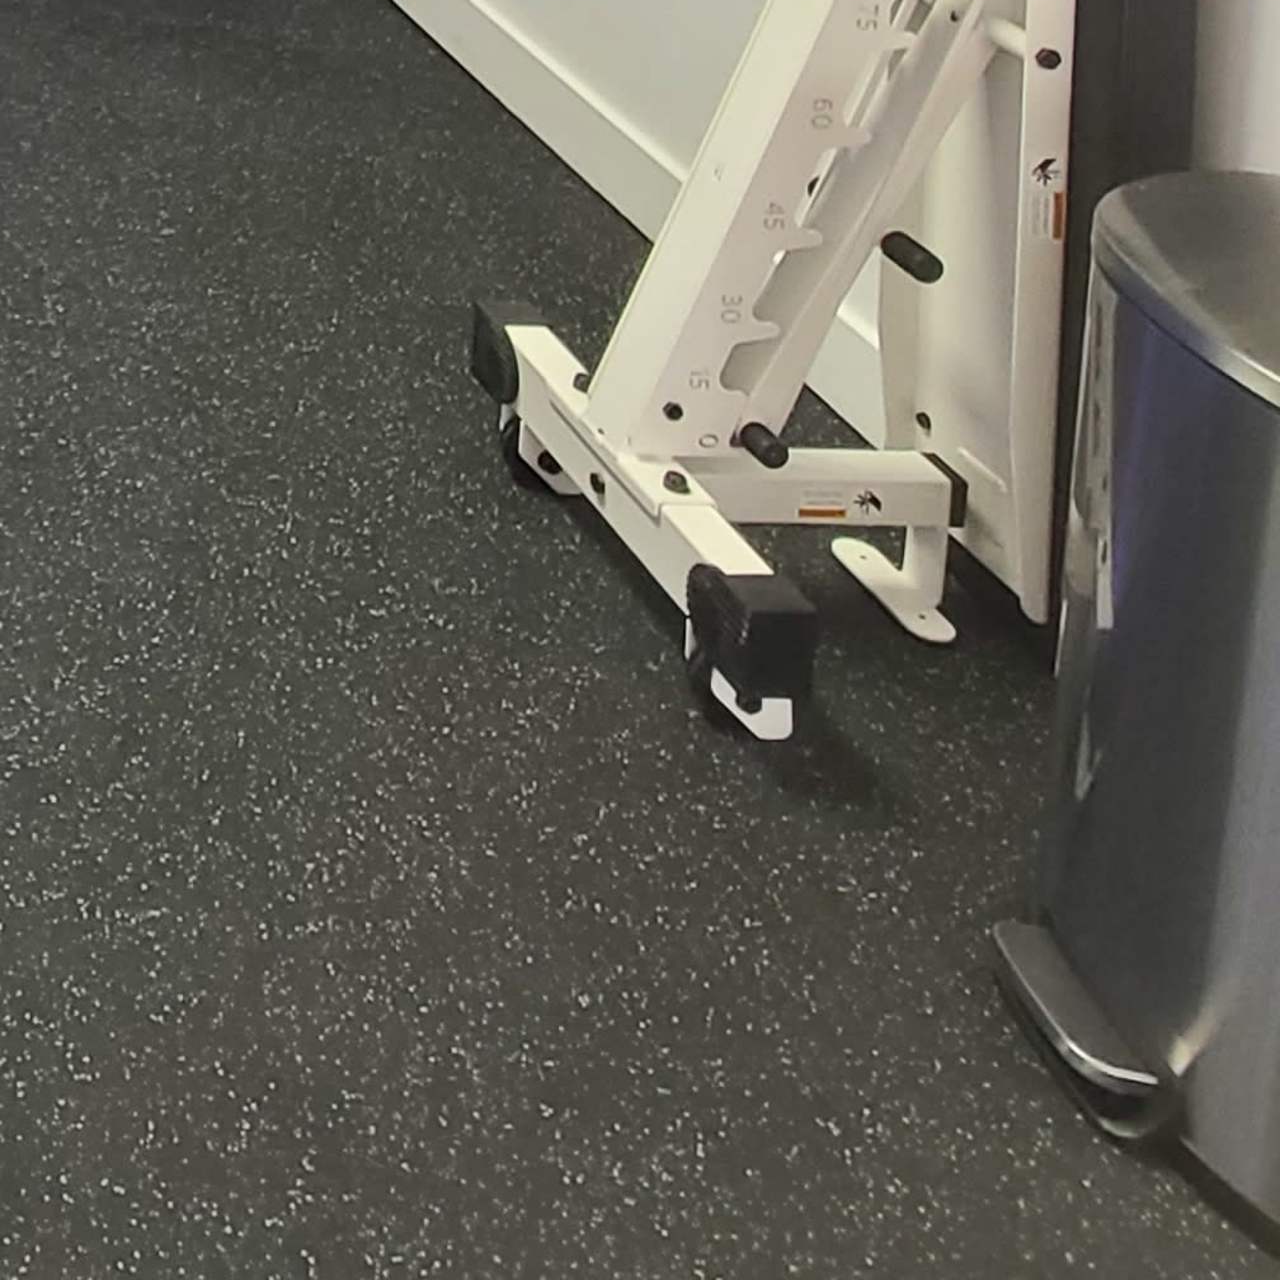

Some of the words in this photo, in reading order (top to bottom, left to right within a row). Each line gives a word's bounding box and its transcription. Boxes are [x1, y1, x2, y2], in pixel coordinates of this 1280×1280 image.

[856, 3, 880, 31] 75
[810, 97, 833, 130] 60
[762, 201, 785, 232] 45
[720, 293, 743, 325] 30
[698, 433, 719, 450] 0
